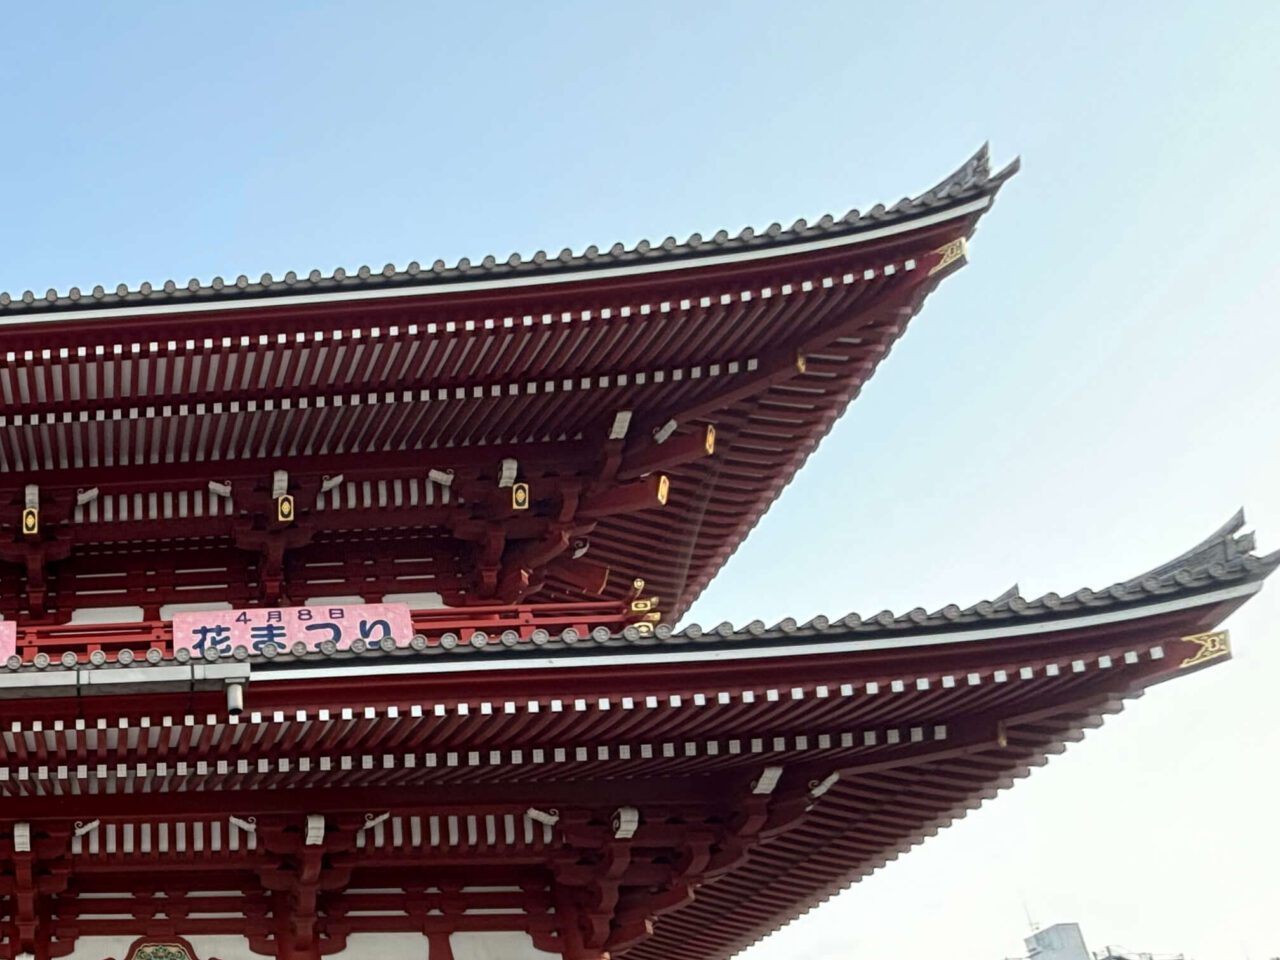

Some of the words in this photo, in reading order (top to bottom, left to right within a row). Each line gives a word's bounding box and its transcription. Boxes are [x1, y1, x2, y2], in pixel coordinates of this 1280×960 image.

[235, 608, 345, 624] 4月8日
[192, 619, 391, 656] 花まつり
